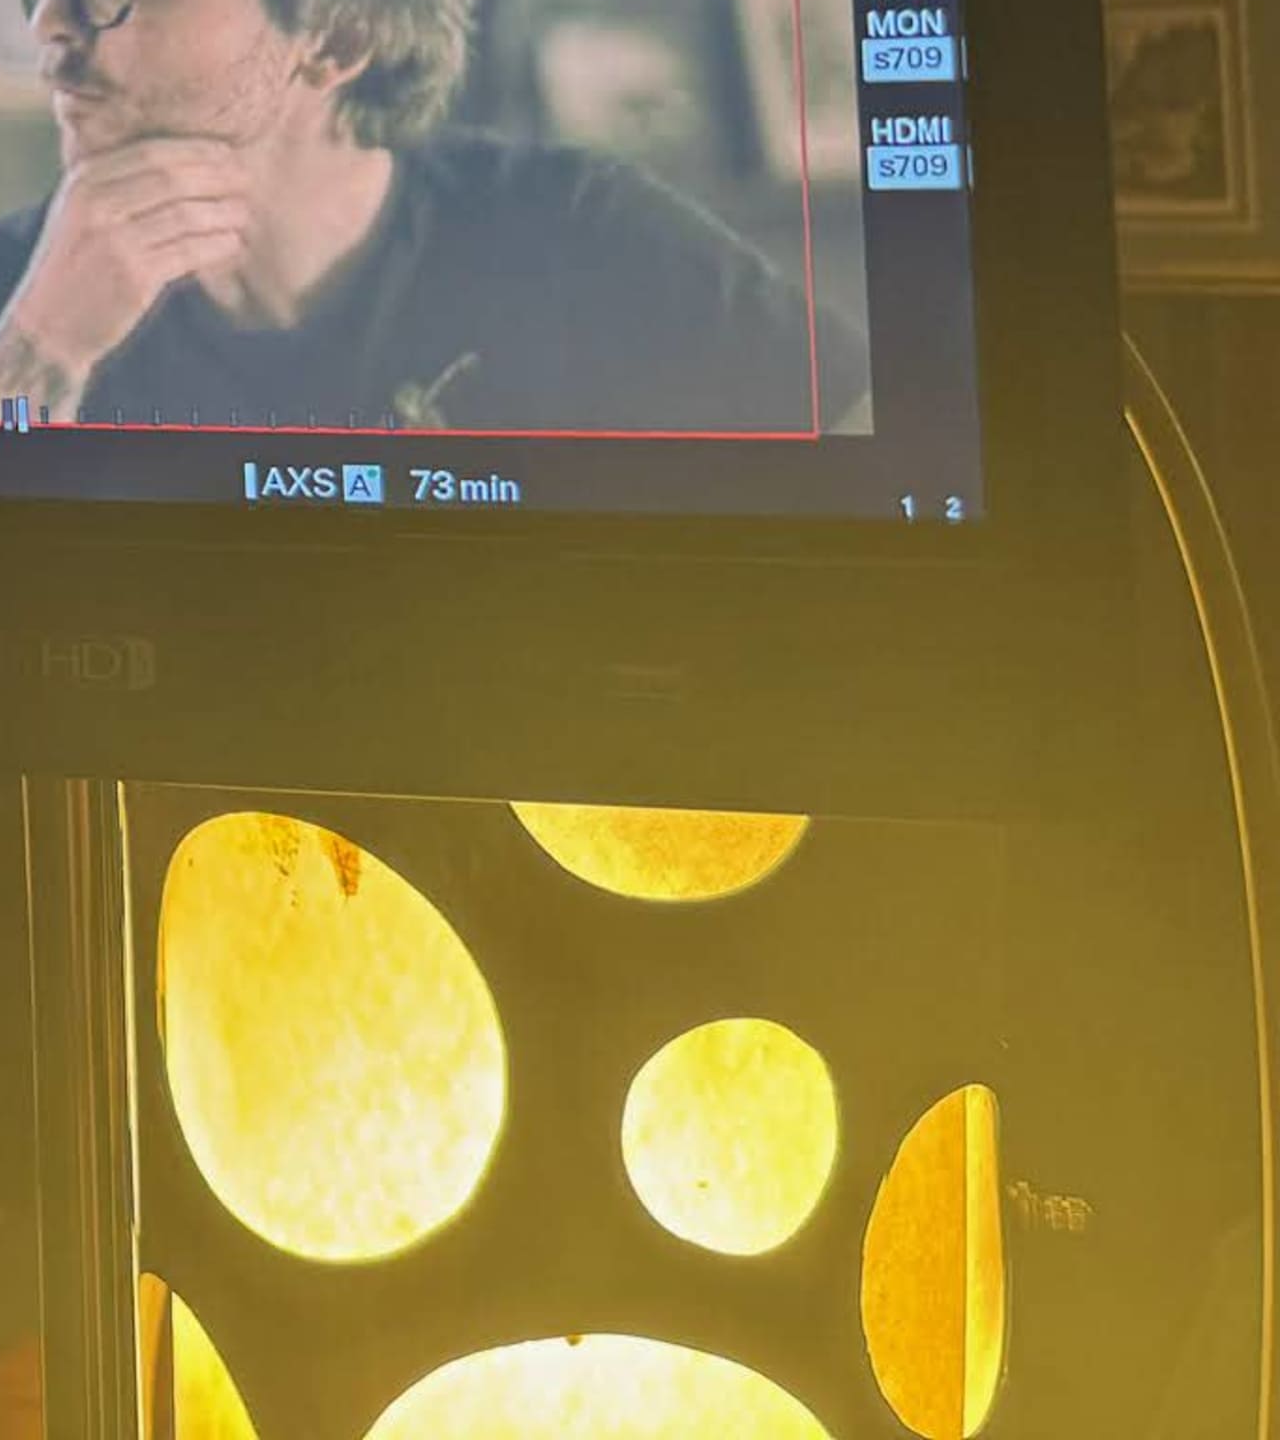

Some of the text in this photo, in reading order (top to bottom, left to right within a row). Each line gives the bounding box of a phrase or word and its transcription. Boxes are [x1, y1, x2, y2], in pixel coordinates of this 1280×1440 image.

[866, 9, 945, 38] MON
[873, 46, 943, 71] s709
[871, 117, 952, 144] HDMI
[878, 154, 949, 178] s709
[260, 465, 338, 498] AXS
[944, 495, 964, 524] 2
